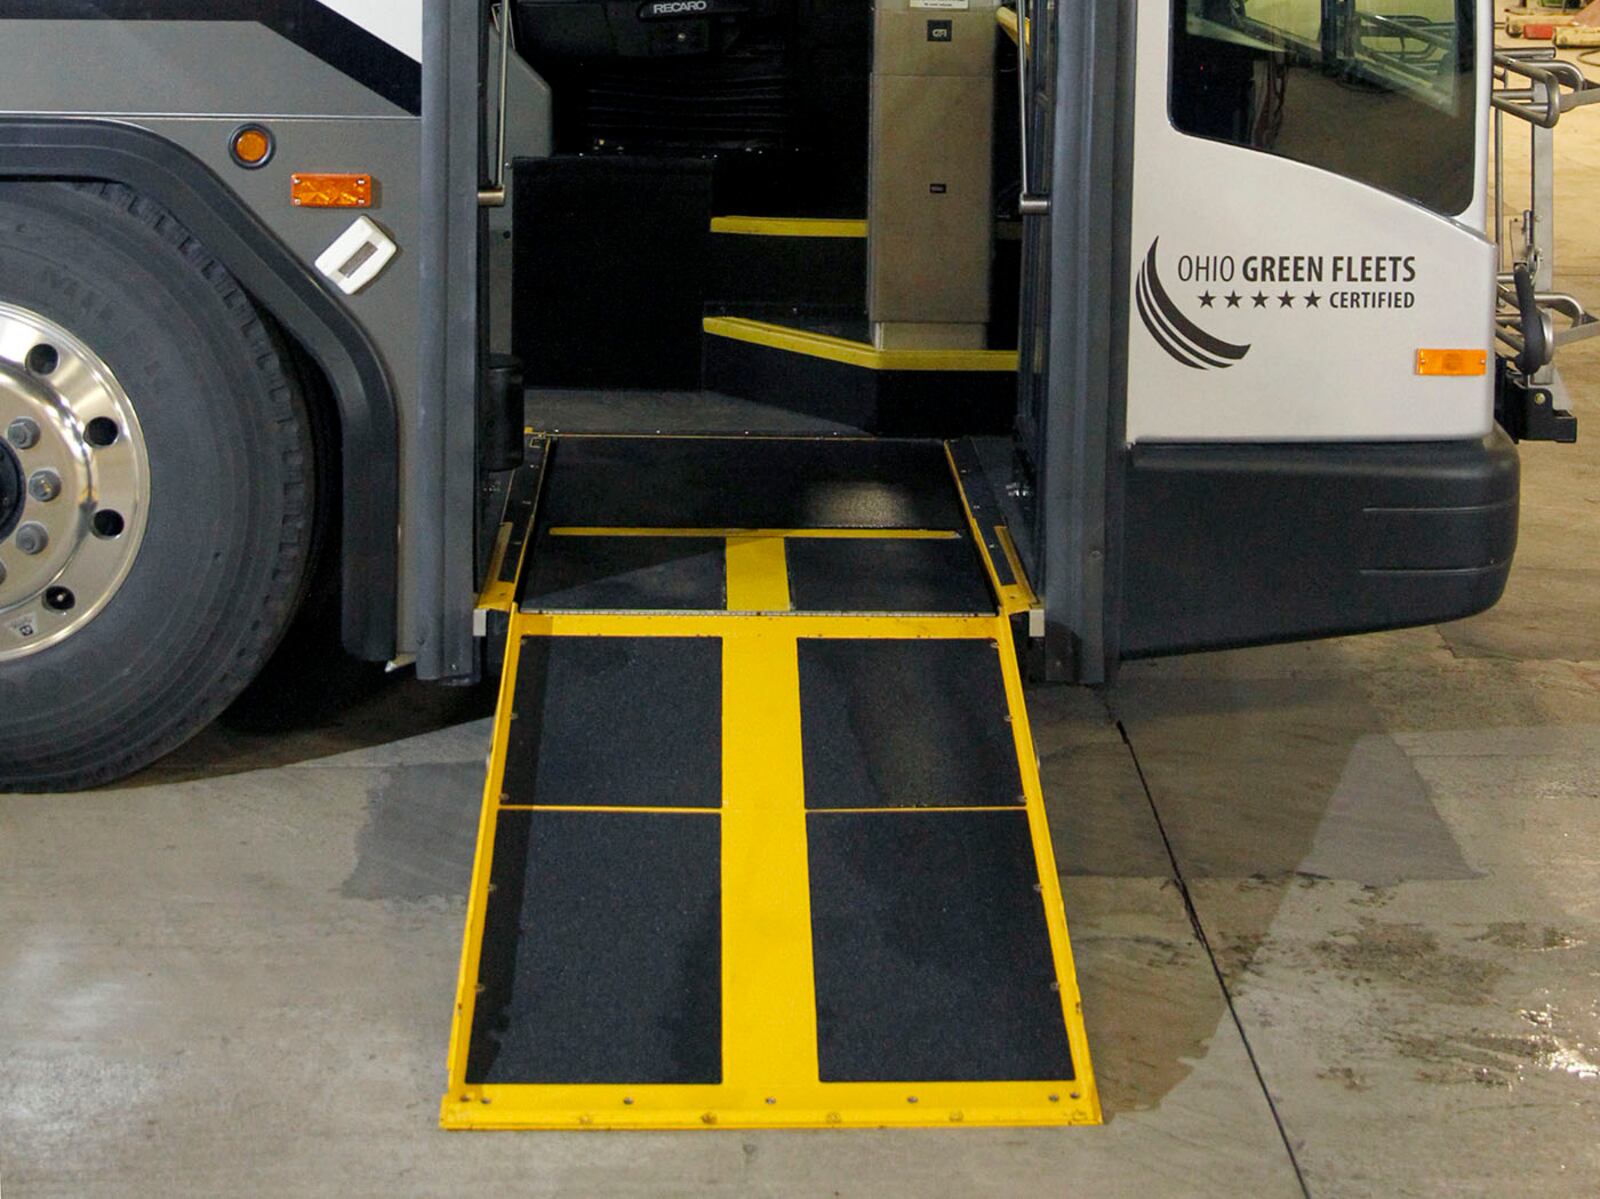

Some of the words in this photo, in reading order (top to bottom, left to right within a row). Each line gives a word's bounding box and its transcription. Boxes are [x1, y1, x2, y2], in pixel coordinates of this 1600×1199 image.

[653, 0, 707, 14] RECARO
[1178, 255, 1235, 282] OHIO
[1242, 255, 1323, 282] GREEN
[1332, 256, 1416, 283] FLEETS
[1330, 291, 1415, 309] CERTIFIED
